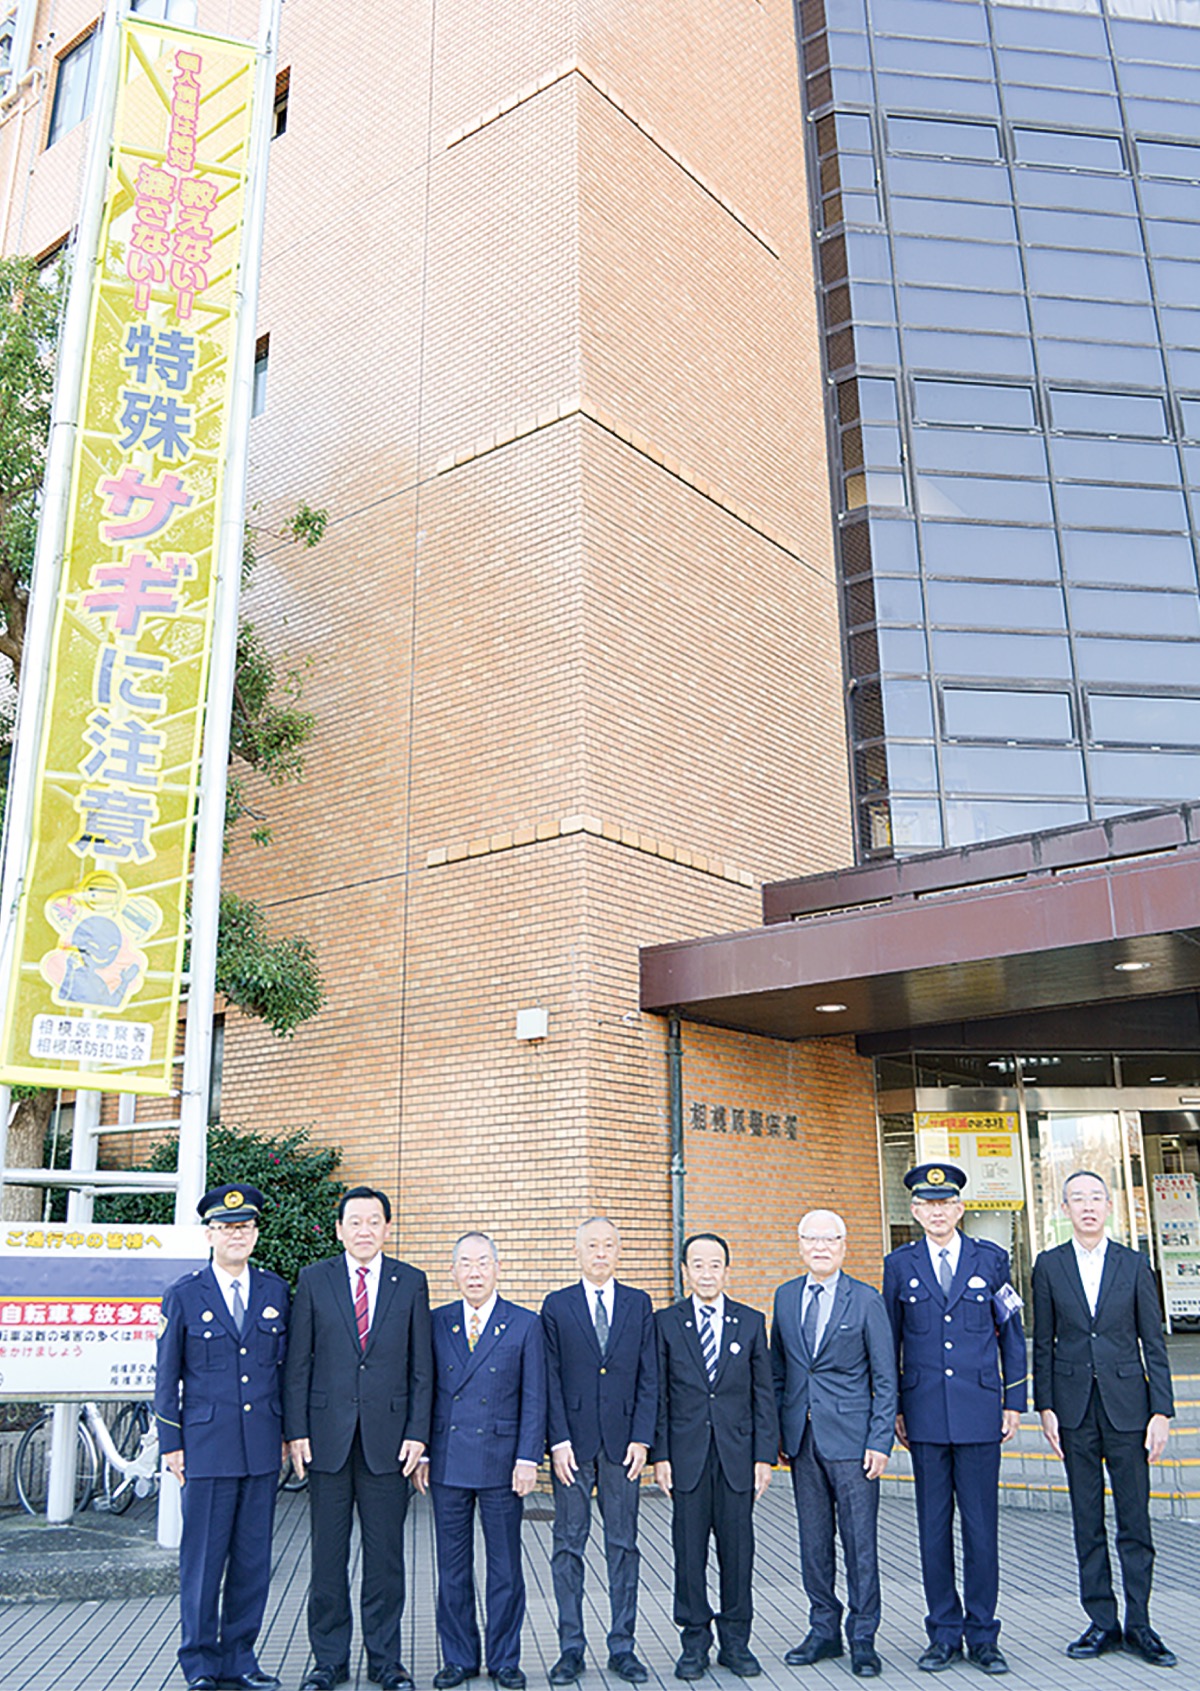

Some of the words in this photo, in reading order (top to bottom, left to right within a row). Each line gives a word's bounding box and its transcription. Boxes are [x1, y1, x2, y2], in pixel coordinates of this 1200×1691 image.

[77, 324, 195, 859] 特殊サギに注意
[6, 1231, 162, 1249] ご通行中の皆様へ
[2, 1303, 161, 1324] 自転車事故多発
